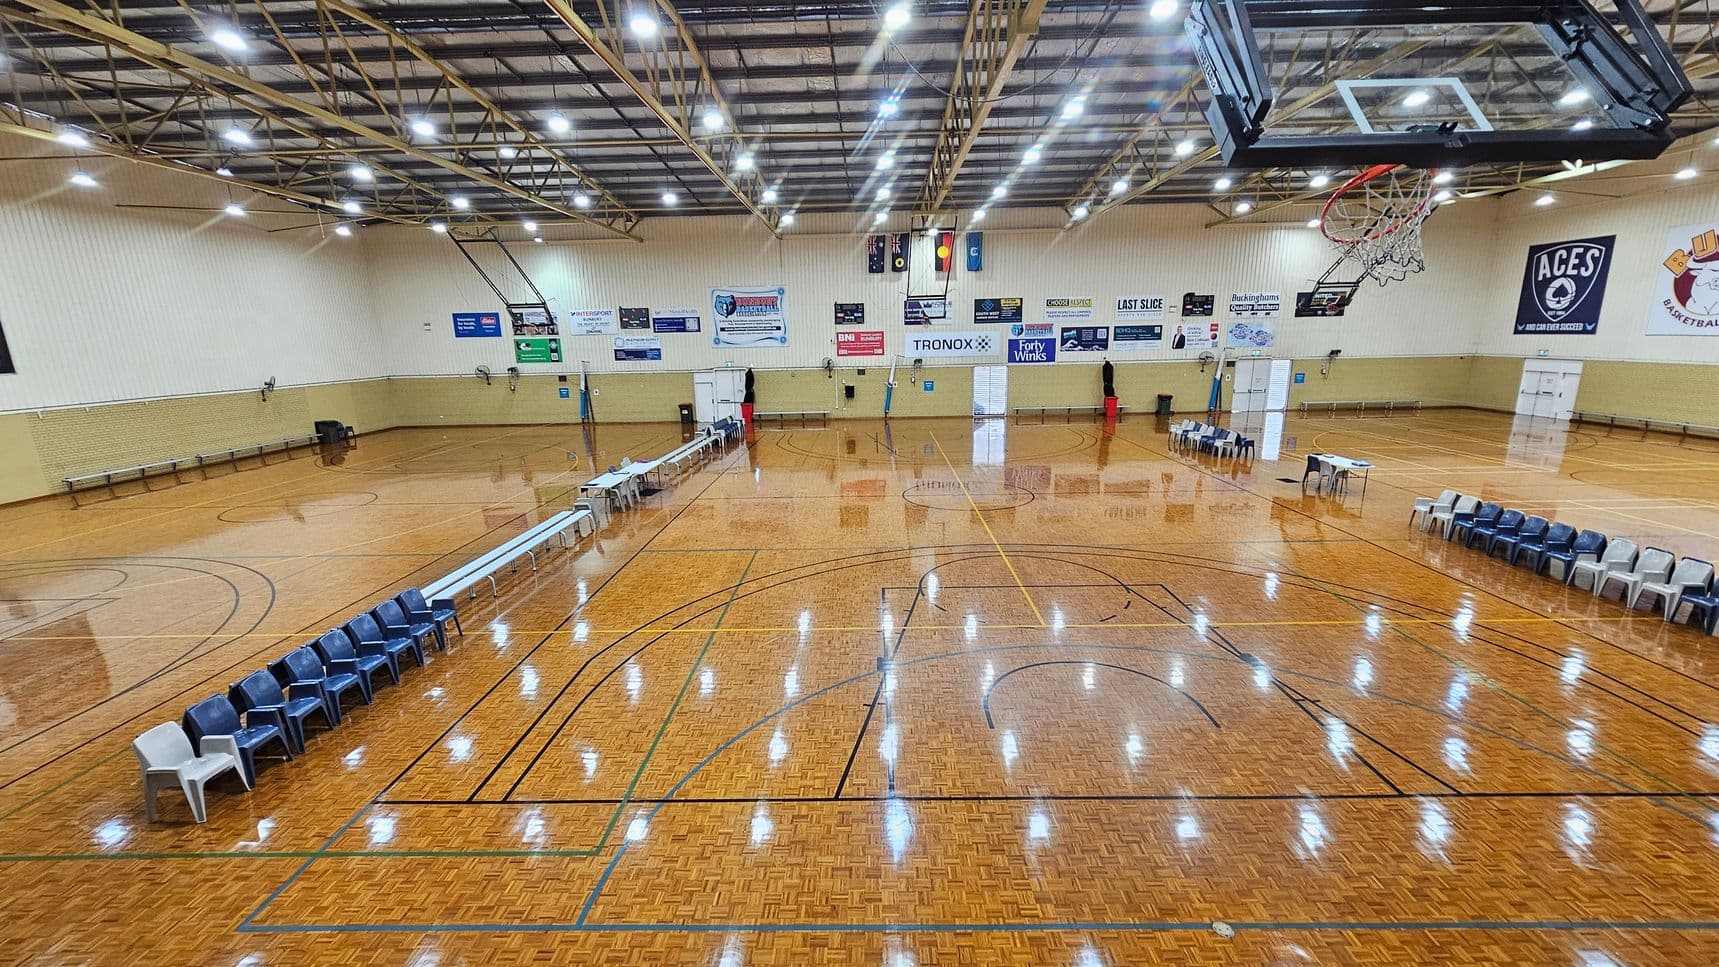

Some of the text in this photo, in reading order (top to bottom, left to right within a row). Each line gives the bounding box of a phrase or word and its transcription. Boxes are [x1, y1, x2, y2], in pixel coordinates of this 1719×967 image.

[1538, 247, 1600, 281] ACES
[1231, 293, 1279, 303] Buckinghams
[736, 305, 779, 313] BASKETBALL
[1118, 298, 1163, 310] LAST SLICE
[1231, 304, 1252, 312] Quality
[1525, 322, 1584, 331] AND CAN EVER SUCCEED
[913, 339, 973, 351] TRONOX
[1020, 340, 1045, 352] Forty
[1014, 351, 1047, 362] Winks
